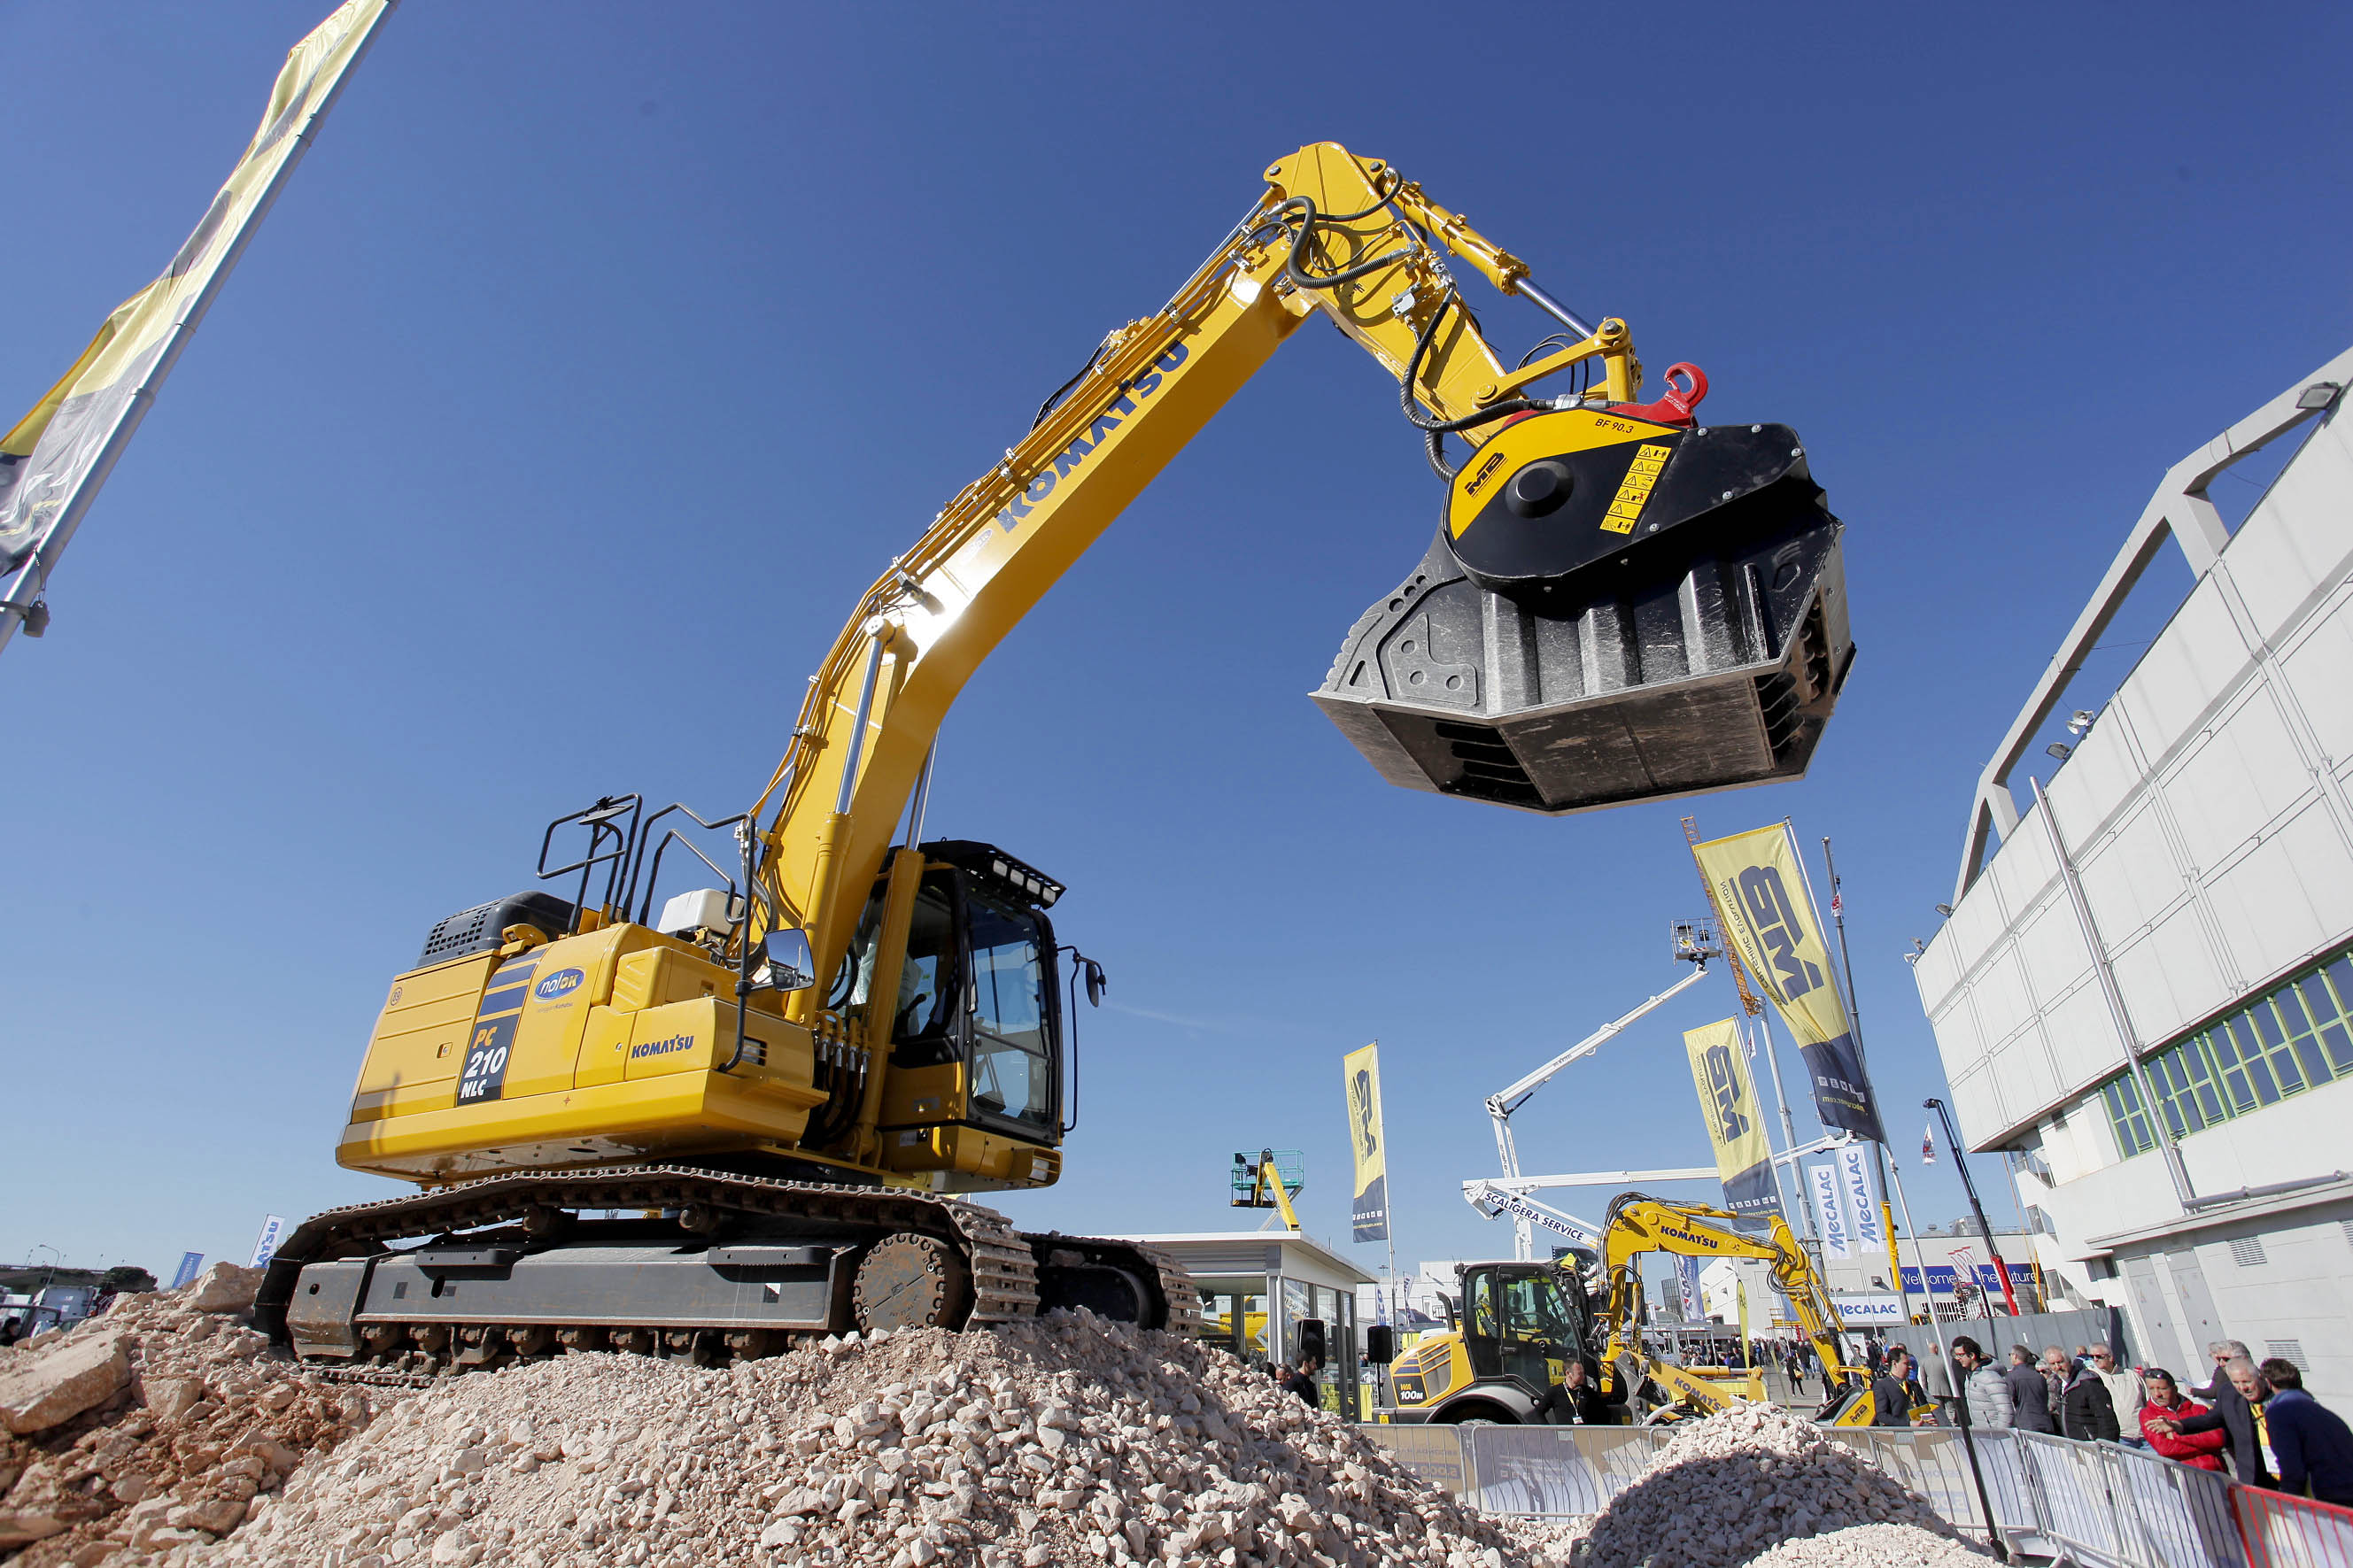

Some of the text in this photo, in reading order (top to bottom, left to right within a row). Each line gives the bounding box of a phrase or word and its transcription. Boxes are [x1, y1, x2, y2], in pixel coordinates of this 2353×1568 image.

[995, 339, 1189, 534] KOMATSU
[1595, 418, 1635, 434] BF 90.3
[1464, 452, 1506, 496] MB
[472, 1026, 498, 1049] PC
[631, 1034, 694, 1059] KOMATSU
[464, 1046, 507, 1078] 210
[461, 1078, 487, 1099] NLC
[1484, 1192, 1584, 1241] SCALIGERA SERVICE
[1660, 1225, 1718, 1249] KOMATSU
[1900, 1272, 1958, 1285] Welome
[1674, 1377, 1727, 1411] KOMATS
